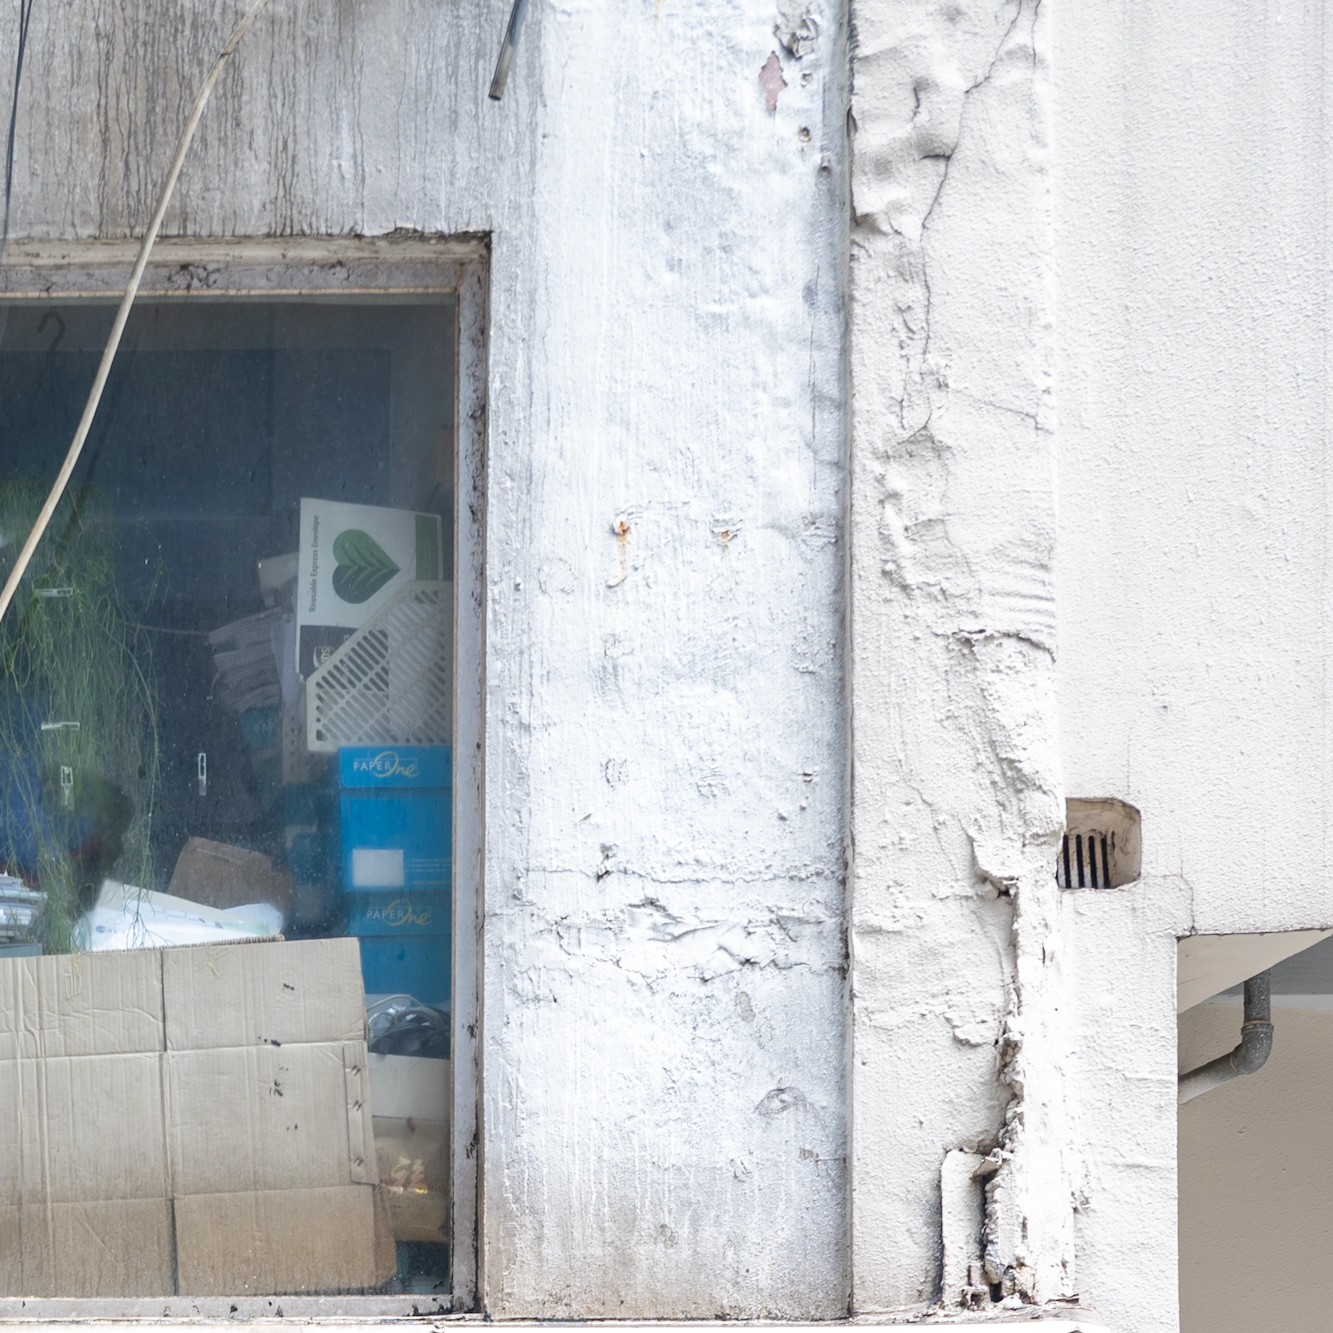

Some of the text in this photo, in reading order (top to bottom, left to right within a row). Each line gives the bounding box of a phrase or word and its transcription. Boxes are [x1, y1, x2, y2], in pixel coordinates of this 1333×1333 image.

[309, 515, 321, 613] Reusable Express Envelope
